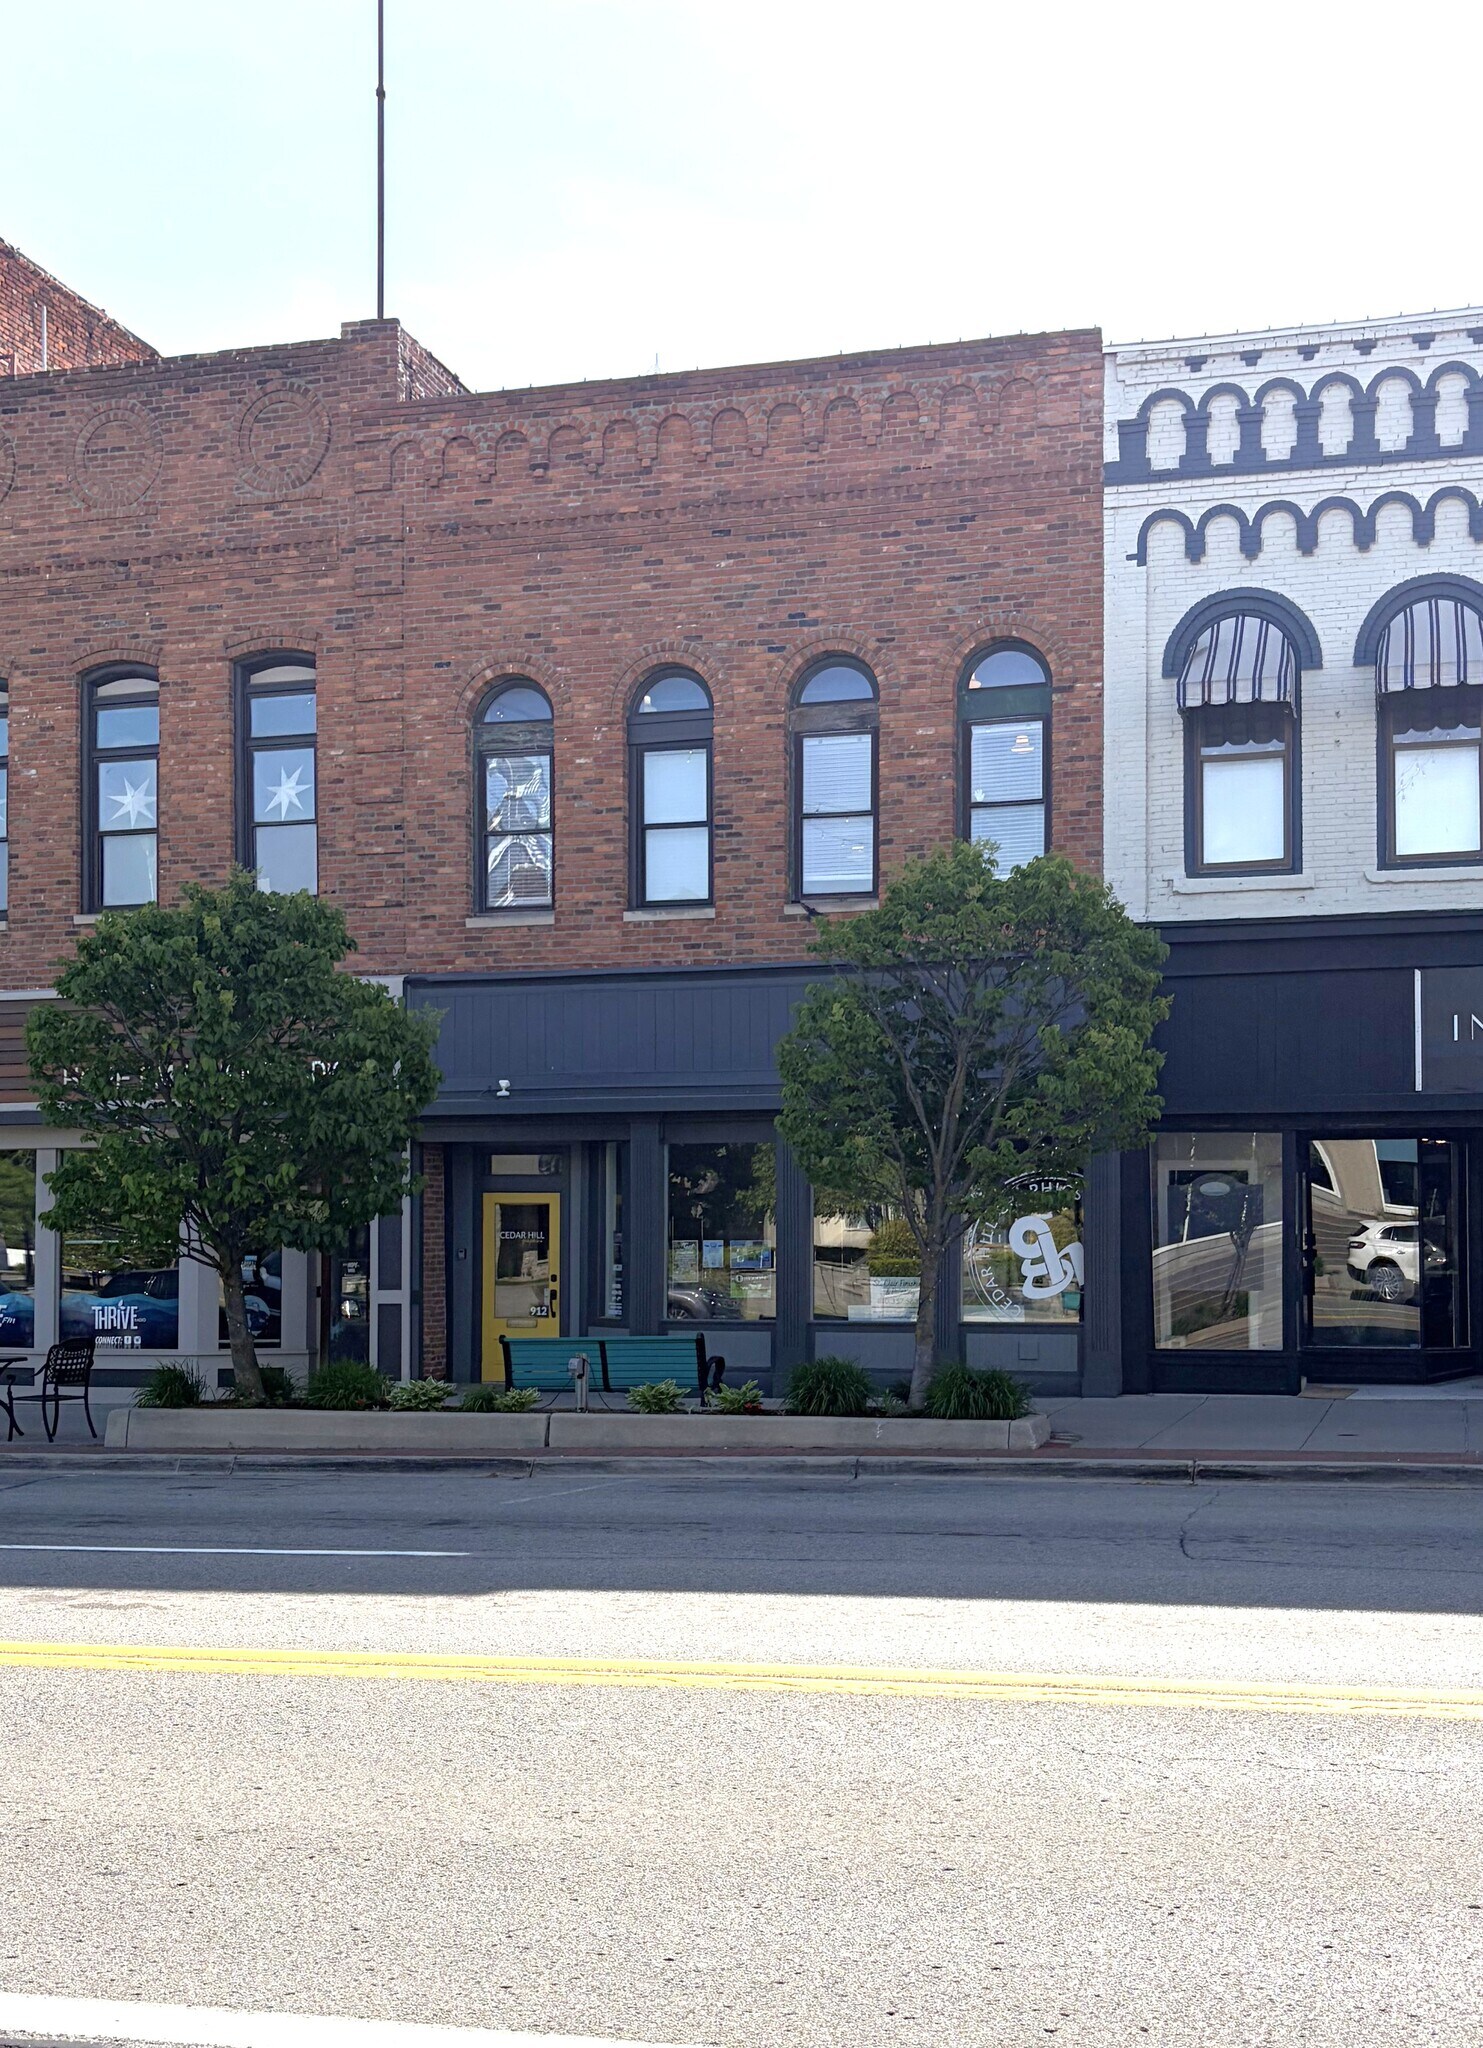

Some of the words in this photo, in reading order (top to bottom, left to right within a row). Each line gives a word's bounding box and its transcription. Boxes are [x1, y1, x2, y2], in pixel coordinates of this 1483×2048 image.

[499, 1231, 526, 1239] CEDAR
[527, 1231, 545, 1239] HILL
[981, 1266, 1022, 1317] CEDAR
[91, 1300, 138, 1330] THRIVE
[530, 1306, 548, 1316] 912
